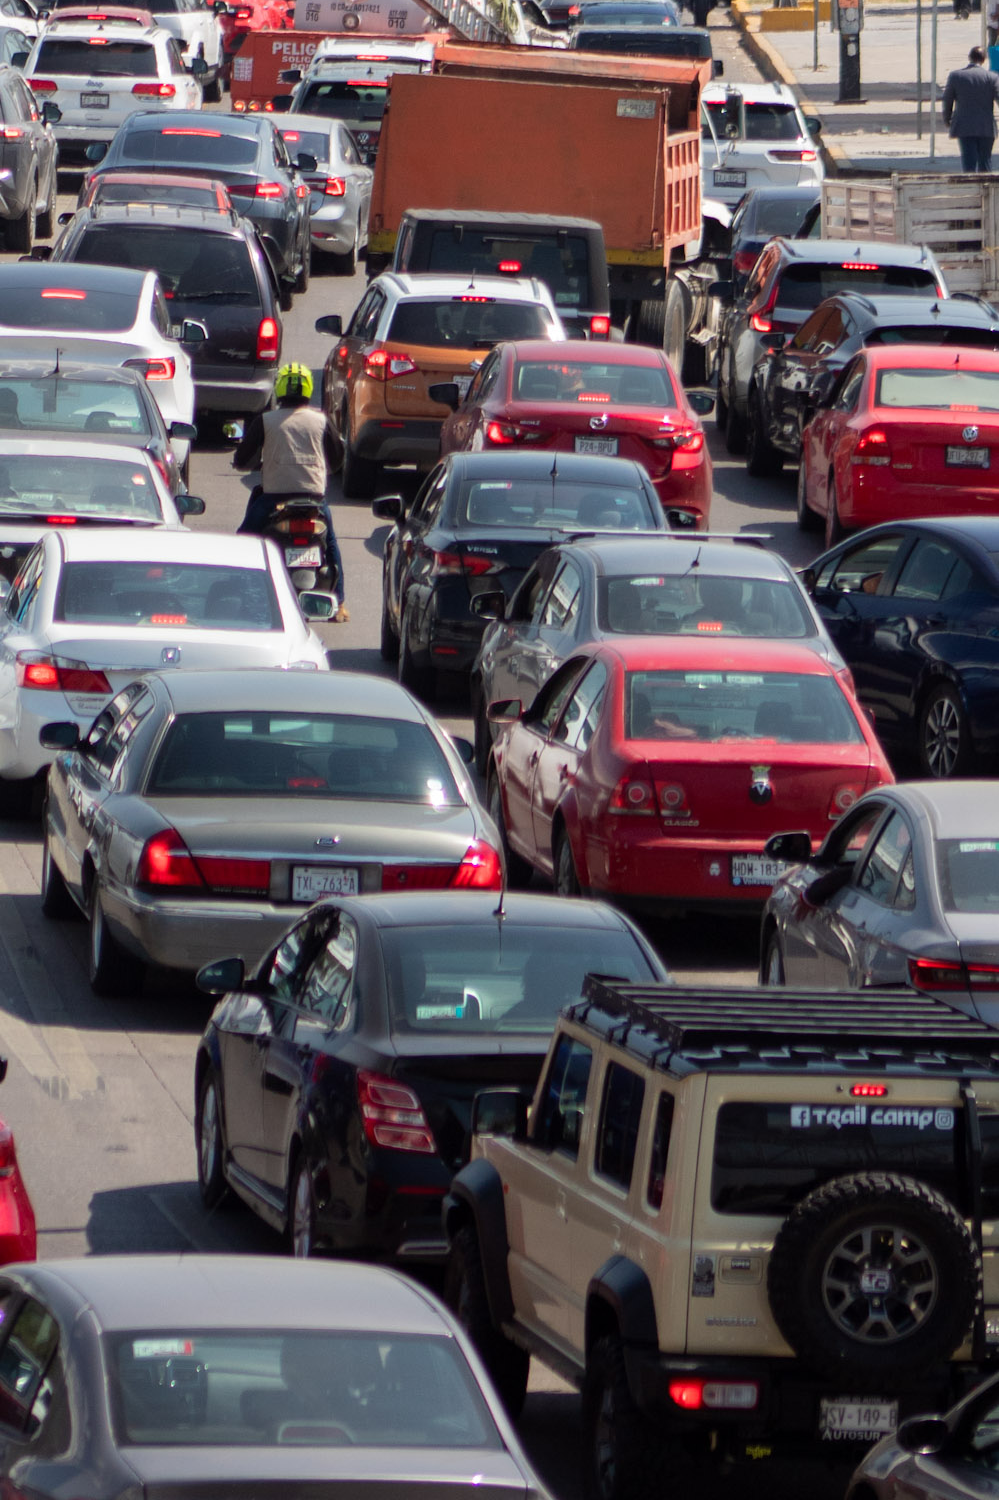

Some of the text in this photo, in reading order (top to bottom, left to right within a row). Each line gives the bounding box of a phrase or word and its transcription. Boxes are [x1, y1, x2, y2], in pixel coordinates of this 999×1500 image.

[272, 41, 317, 56] PELIG
[281, 55, 311, 63] SOLIC
[732, 861, 790, 877] HDW-183-
[822, 1428, 881, 1441] AUTOSUR
